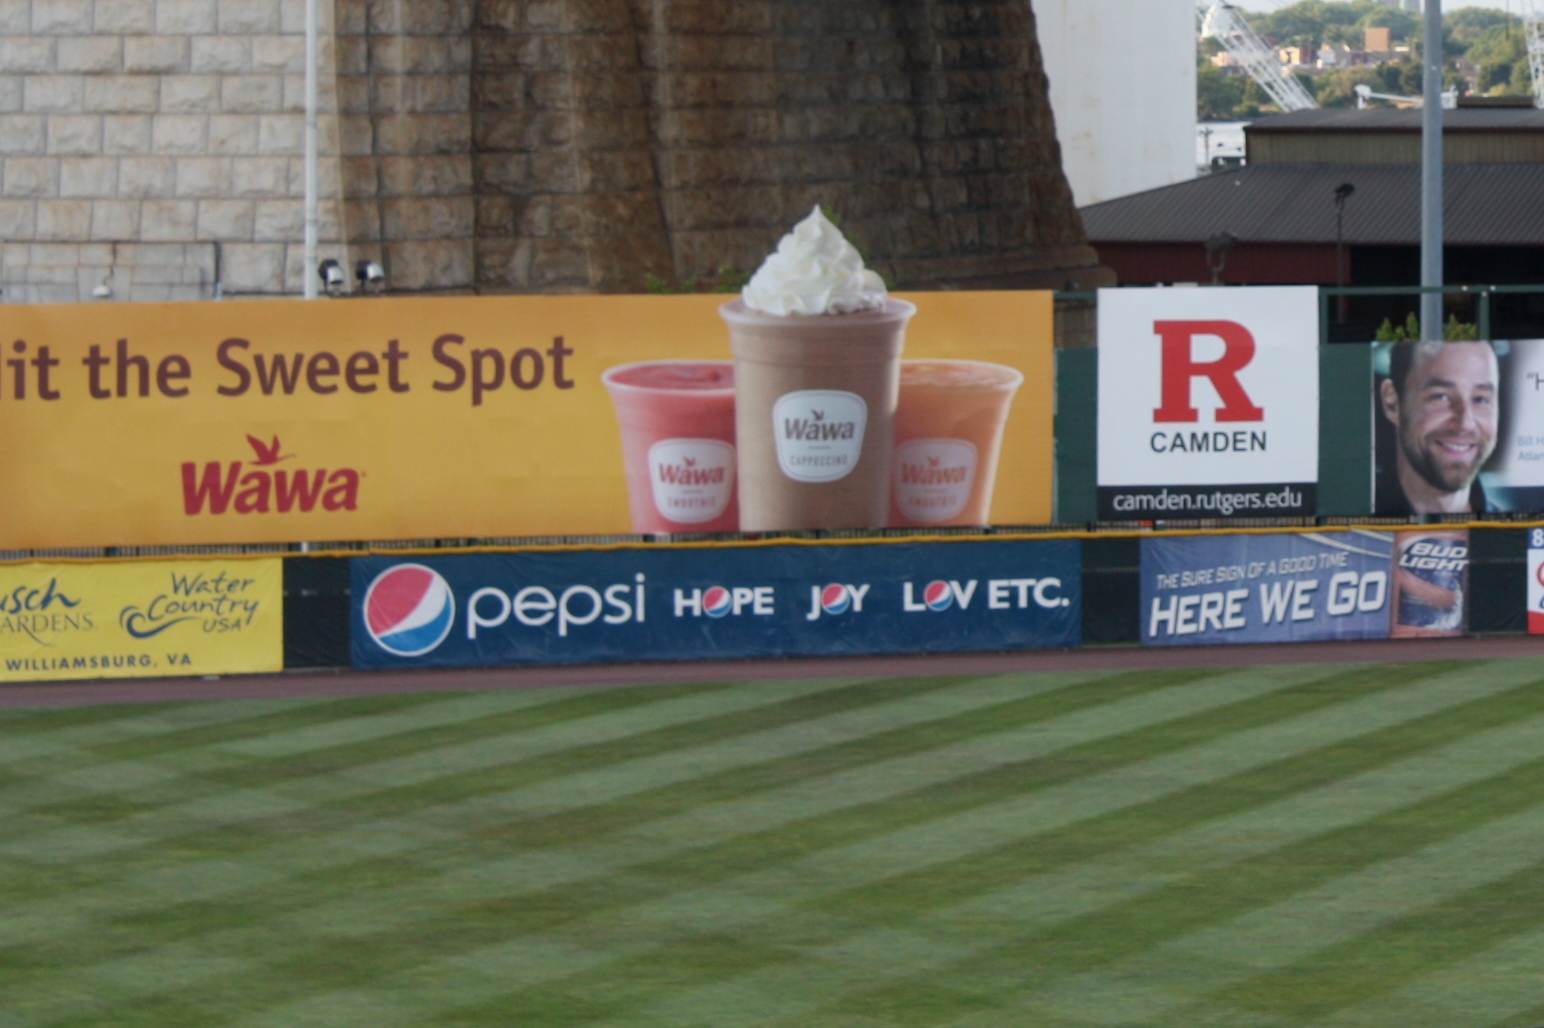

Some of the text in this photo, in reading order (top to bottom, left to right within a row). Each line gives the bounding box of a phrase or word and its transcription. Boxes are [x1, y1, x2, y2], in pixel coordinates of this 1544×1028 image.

[0, 333, 575, 407] it the Sweet Spot
[1152, 319, 1264, 423] R
[784, 419, 855, 441] Wawa
[1151, 431, 1267, 453] CAMDEN
[1517, 436, 1533, 446] Bill
[659, 464, 724, 485] Wawa
[901, 463, 967, 485] Wawa
[181, 460, 360, 516] Wawa
[1113, 486, 1302, 514] camden.rutgers.edu
[1399, 554, 1470, 572] LIGHT
[1411, 542, 1468, 559] BUD
[1157, 551, 1350, 589] THE SURE SIGN OF A GOOD TIME
[171, 571, 255, 596] Water
[988, 578, 1070, 608] ETC.
[147, 594, 259, 625] Country
[467, 572, 645, 639] pepsi
[1149, 570, 1388, 638] HERE WE GO
[202, 619, 242, 633] USA
[6, 653, 192, 670] WILLIAMSBURG, VA
